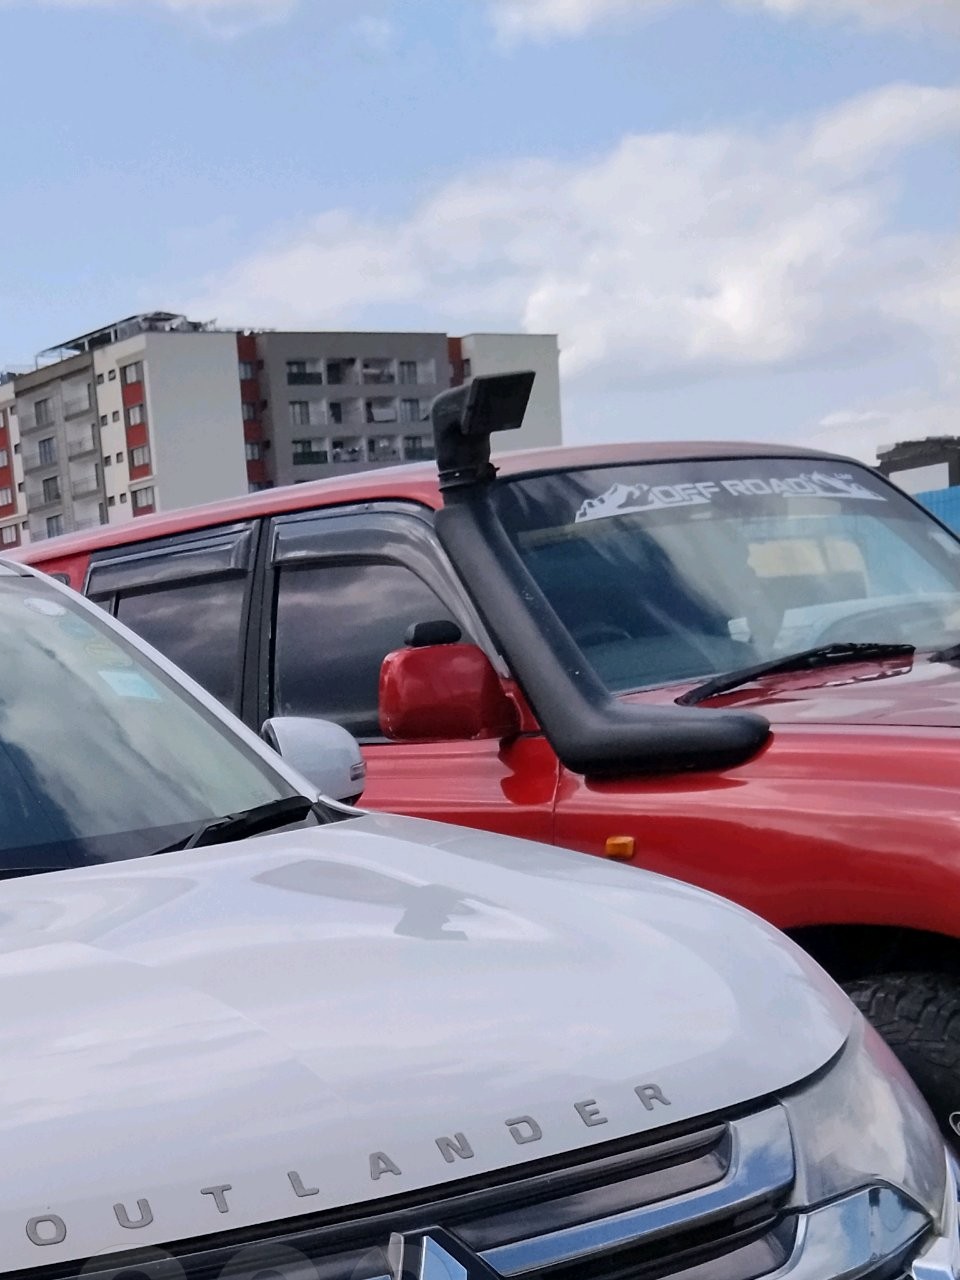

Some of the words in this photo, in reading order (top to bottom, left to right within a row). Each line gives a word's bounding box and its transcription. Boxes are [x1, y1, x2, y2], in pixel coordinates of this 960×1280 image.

[651, 481, 720, 502] OFF
[721, 477, 814, 496] ROAD
[25, 1082, 672, 1247] OUTLANDER
